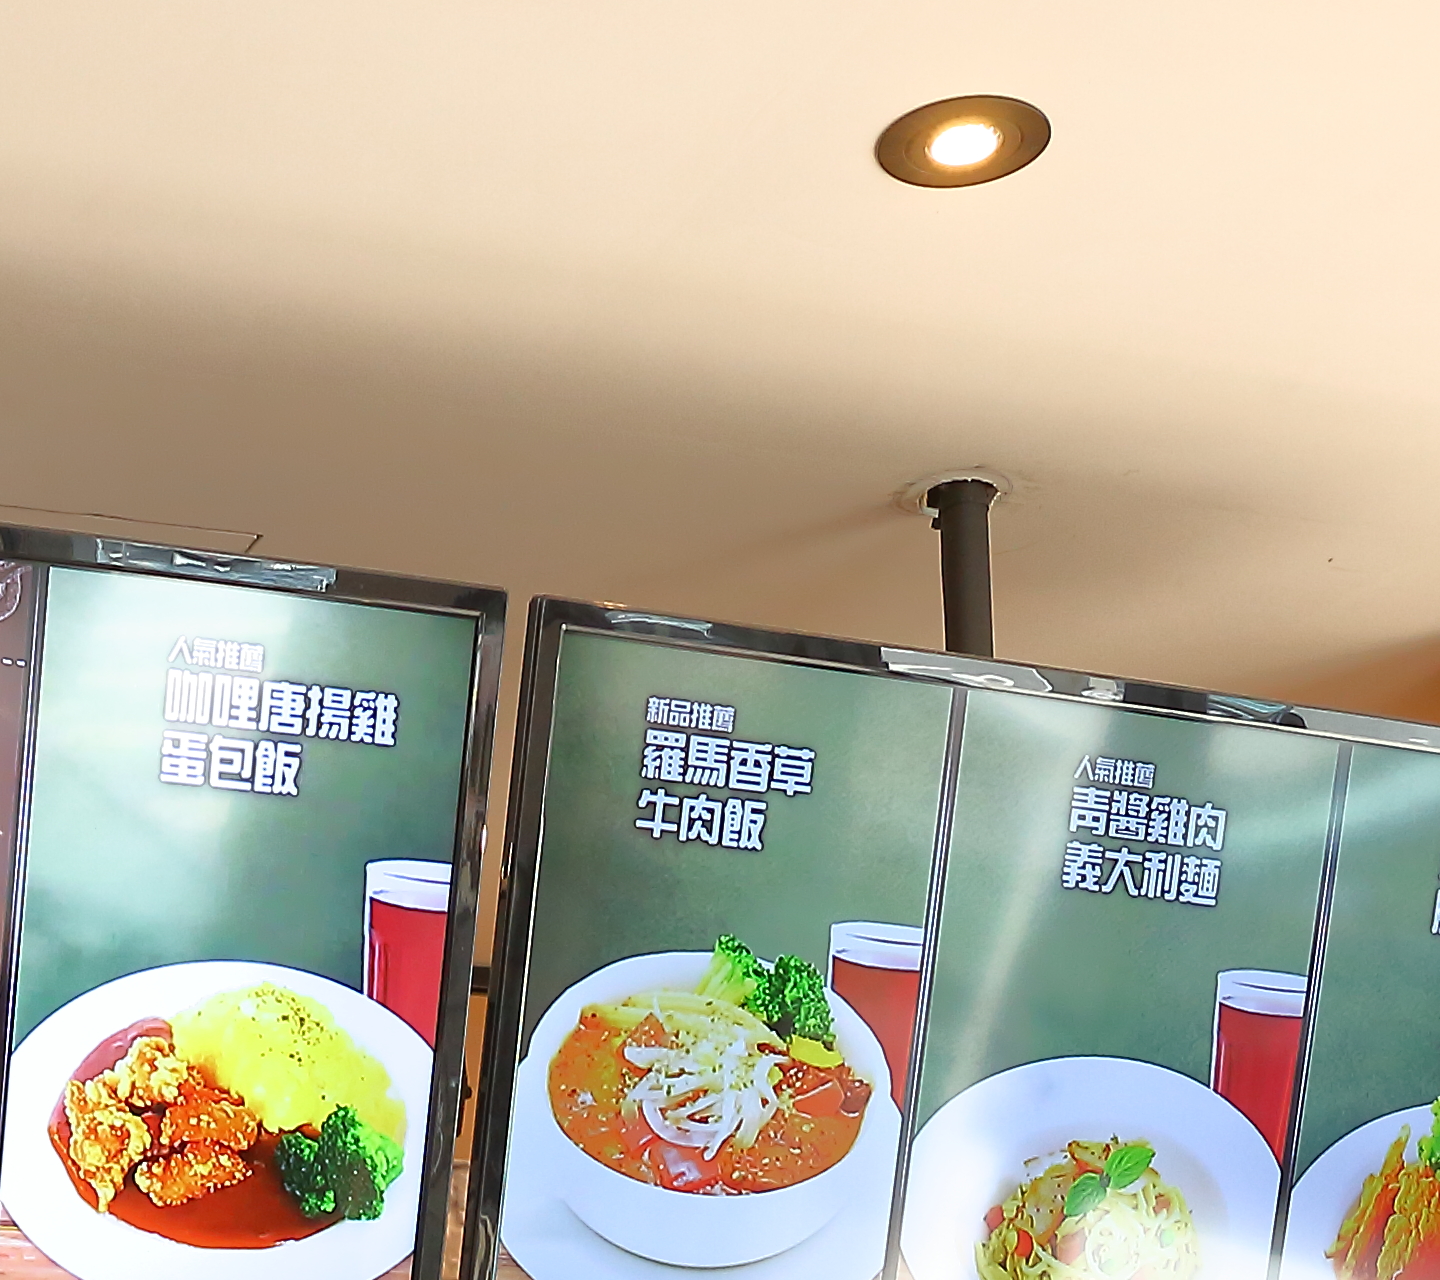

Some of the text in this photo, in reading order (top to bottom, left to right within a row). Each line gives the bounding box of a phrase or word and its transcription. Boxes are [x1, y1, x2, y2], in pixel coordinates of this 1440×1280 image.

[646, 695, 737, 734] 新品推薦
[158, 729, 304, 798] 蛋包飯
[640, 728, 817, 799] 羅馬香草
[1073, 754, 1156, 790] 人氣推薦
[634, 788, 769, 853] 牛肉飯
[1068, 784, 1229, 855] 青醬雞肉
[1061, 838, 1224, 908] 義大利麵
